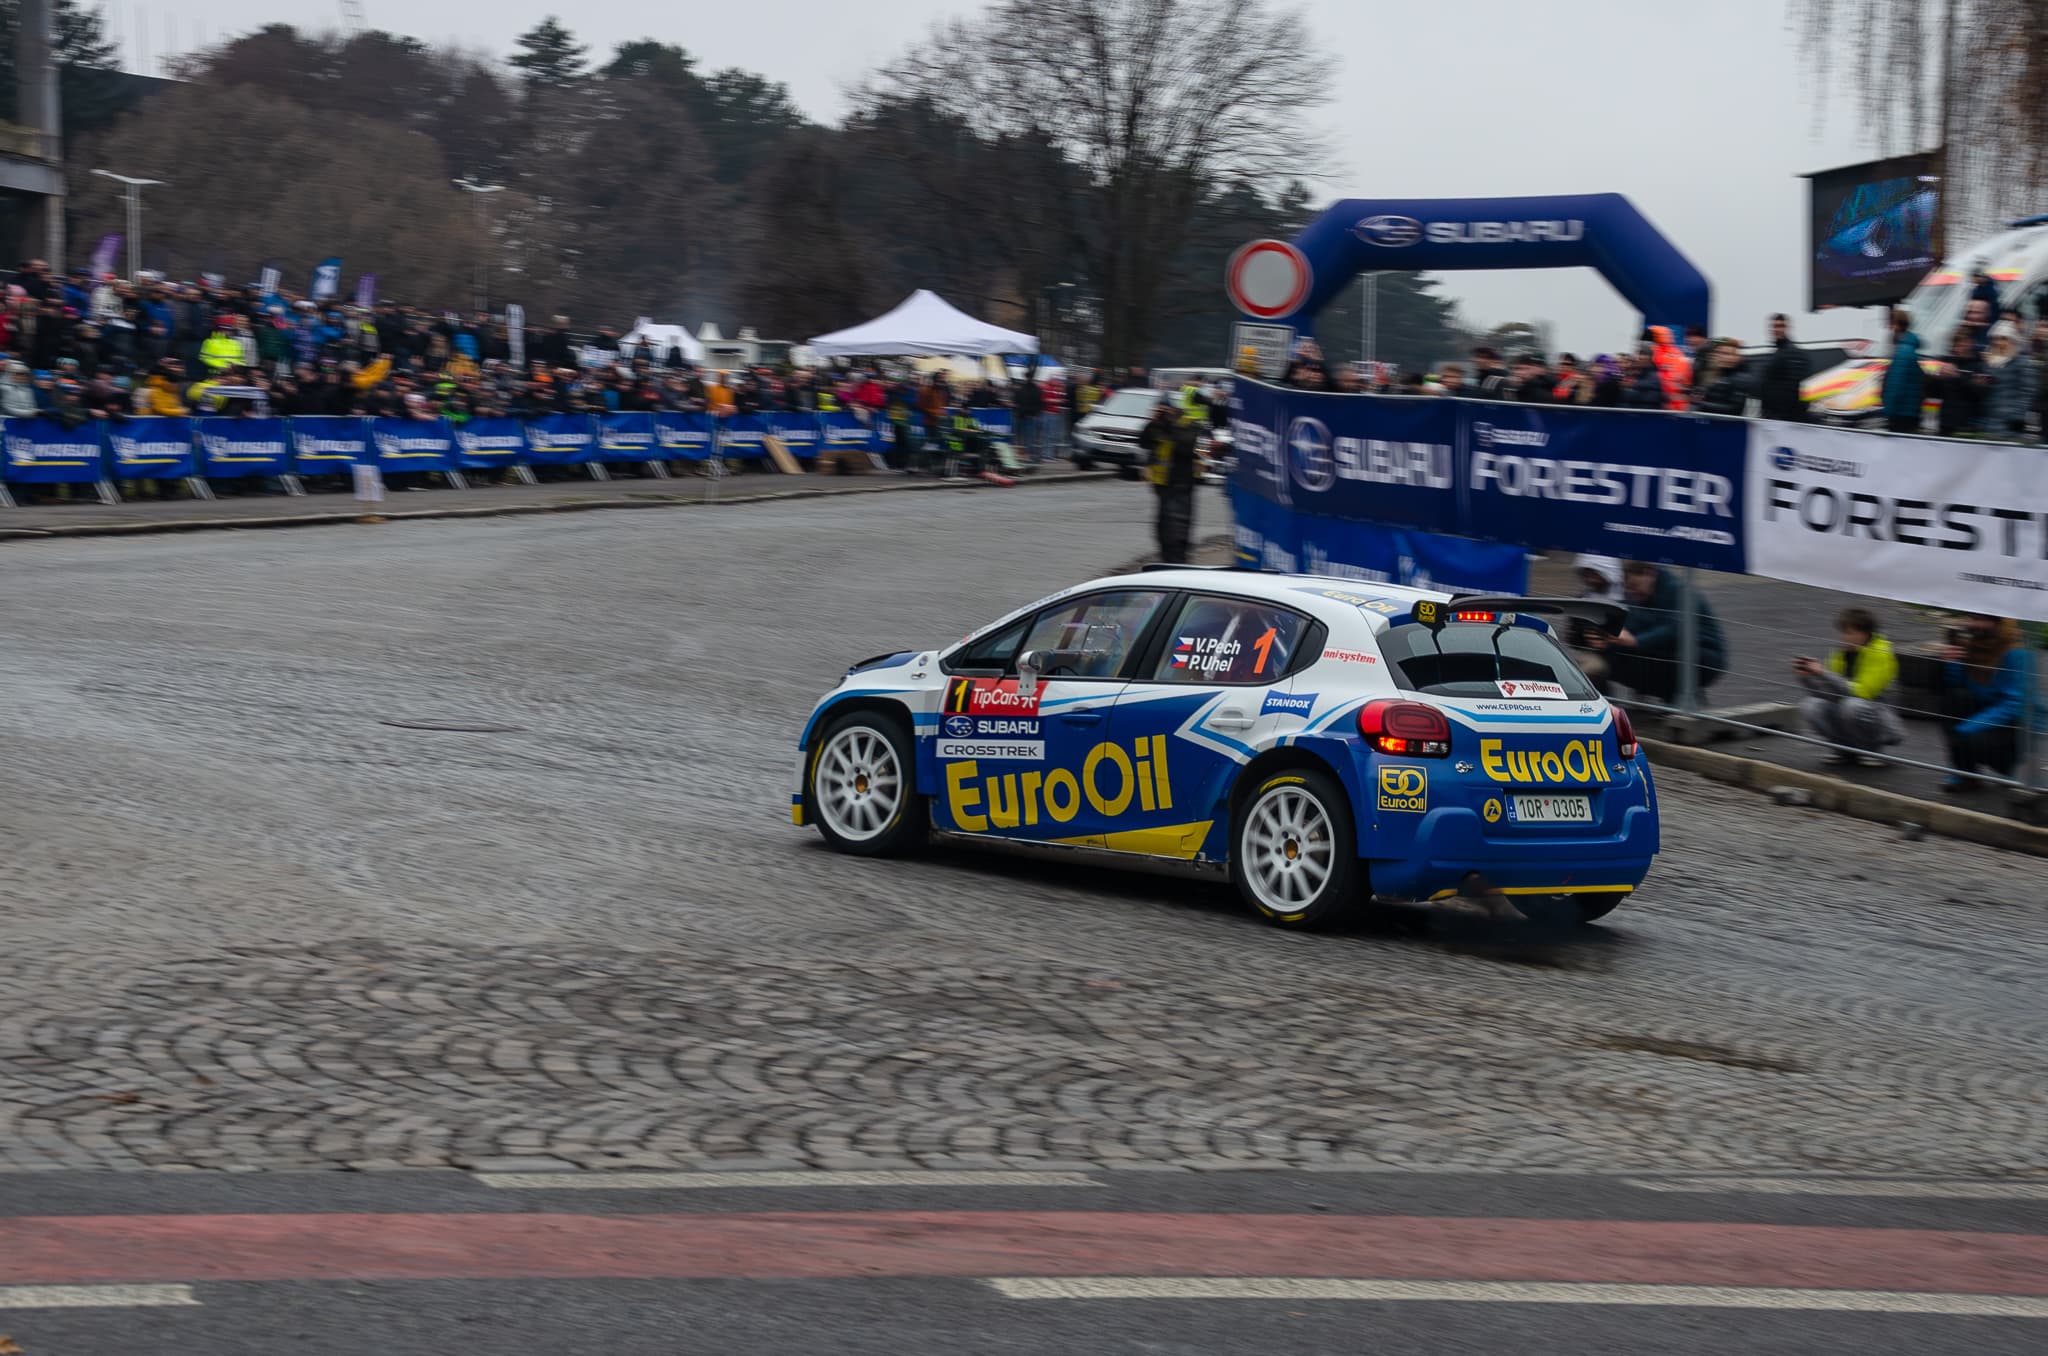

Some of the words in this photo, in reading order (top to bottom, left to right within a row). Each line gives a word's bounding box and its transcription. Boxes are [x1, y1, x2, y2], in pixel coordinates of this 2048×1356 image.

[1424, 219, 1584, 243] SUBARU
[1334, 436, 1452, 489] SUBARU
[1470, 450, 1735, 518] FORESTER
[1763, 477, 2048, 560] FOREST
[1196, 637, 1241, 656] V.Pech
[1253, 627, 1277, 674] 1
[1188, 654, 1233, 672] P.Uhel
[954, 679, 969, 713] 1
[973, 687, 1020, 709] TipCars
[1265, 697, 1310, 709] STANDOX
[977, 720, 1039, 734] SUBARU
[943, 744, 1038, 757] CROSSTREK
[1480, 739, 1611, 782] EuroOil
[945, 734, 1173, 832] EuroOil
[1381, 768, 1425, 796] EO
[1381, 796, 1424, 809] EuroOil
[1519, 800, 1544, 818] 10R
[1552, 800, 1586, 818] 0305
